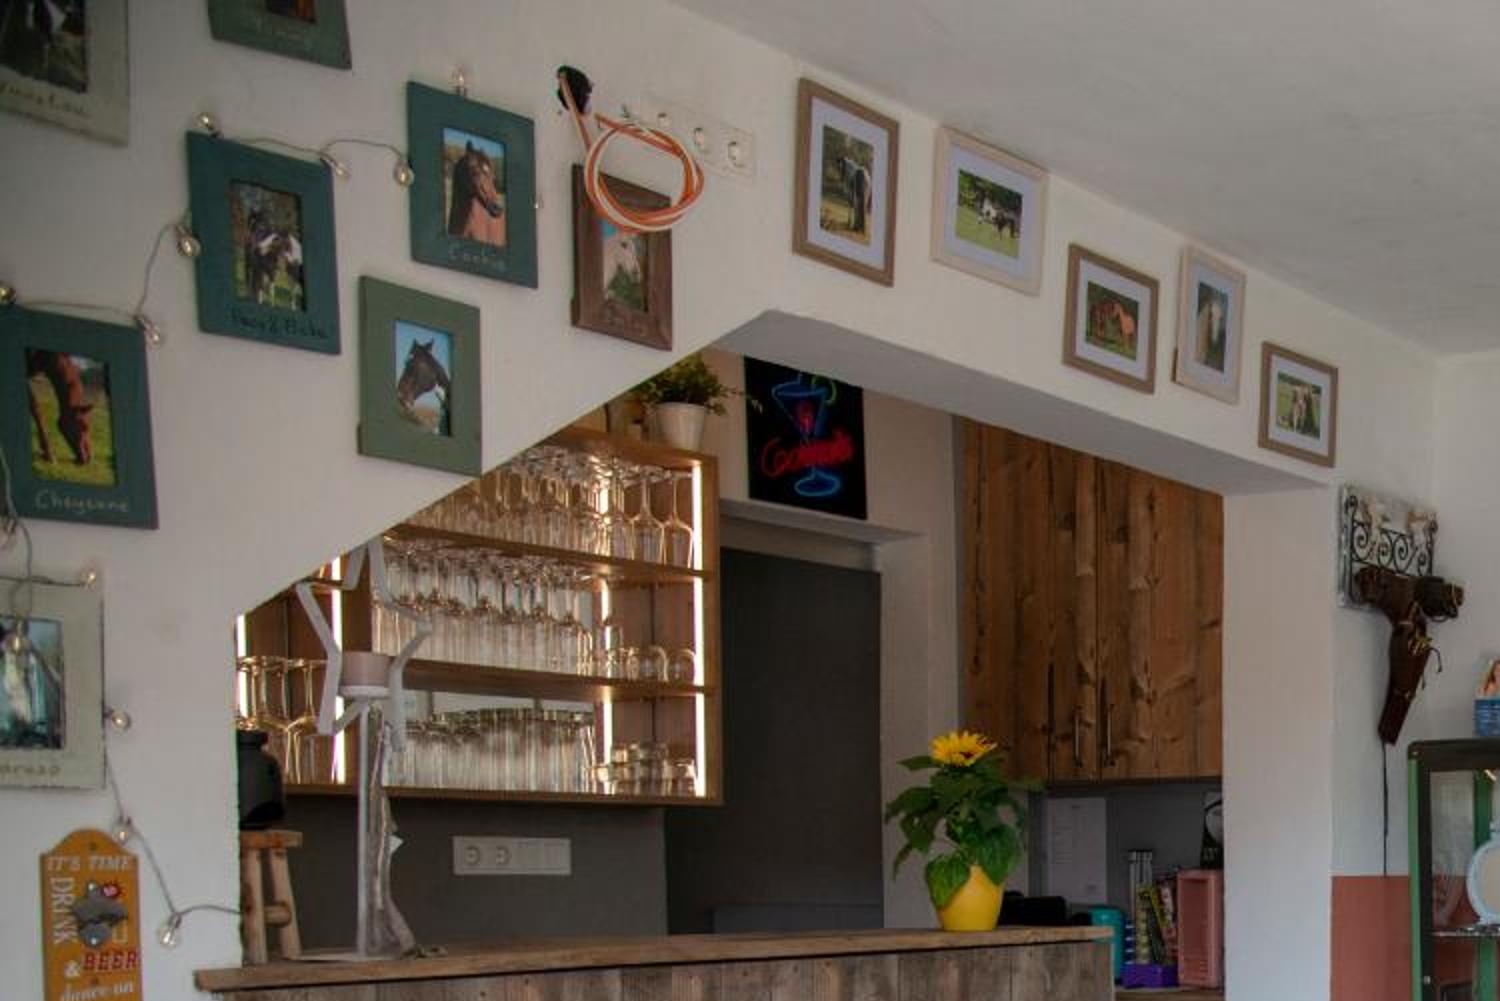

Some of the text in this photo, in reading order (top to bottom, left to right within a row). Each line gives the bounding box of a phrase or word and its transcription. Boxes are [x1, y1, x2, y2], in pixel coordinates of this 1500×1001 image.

[47, 855, 130, 873] IT'S TIME
[50, 876, 79, 945] DRINK
[64, 959, 81, 978] &
[83, 950, 138, 971] BEER
